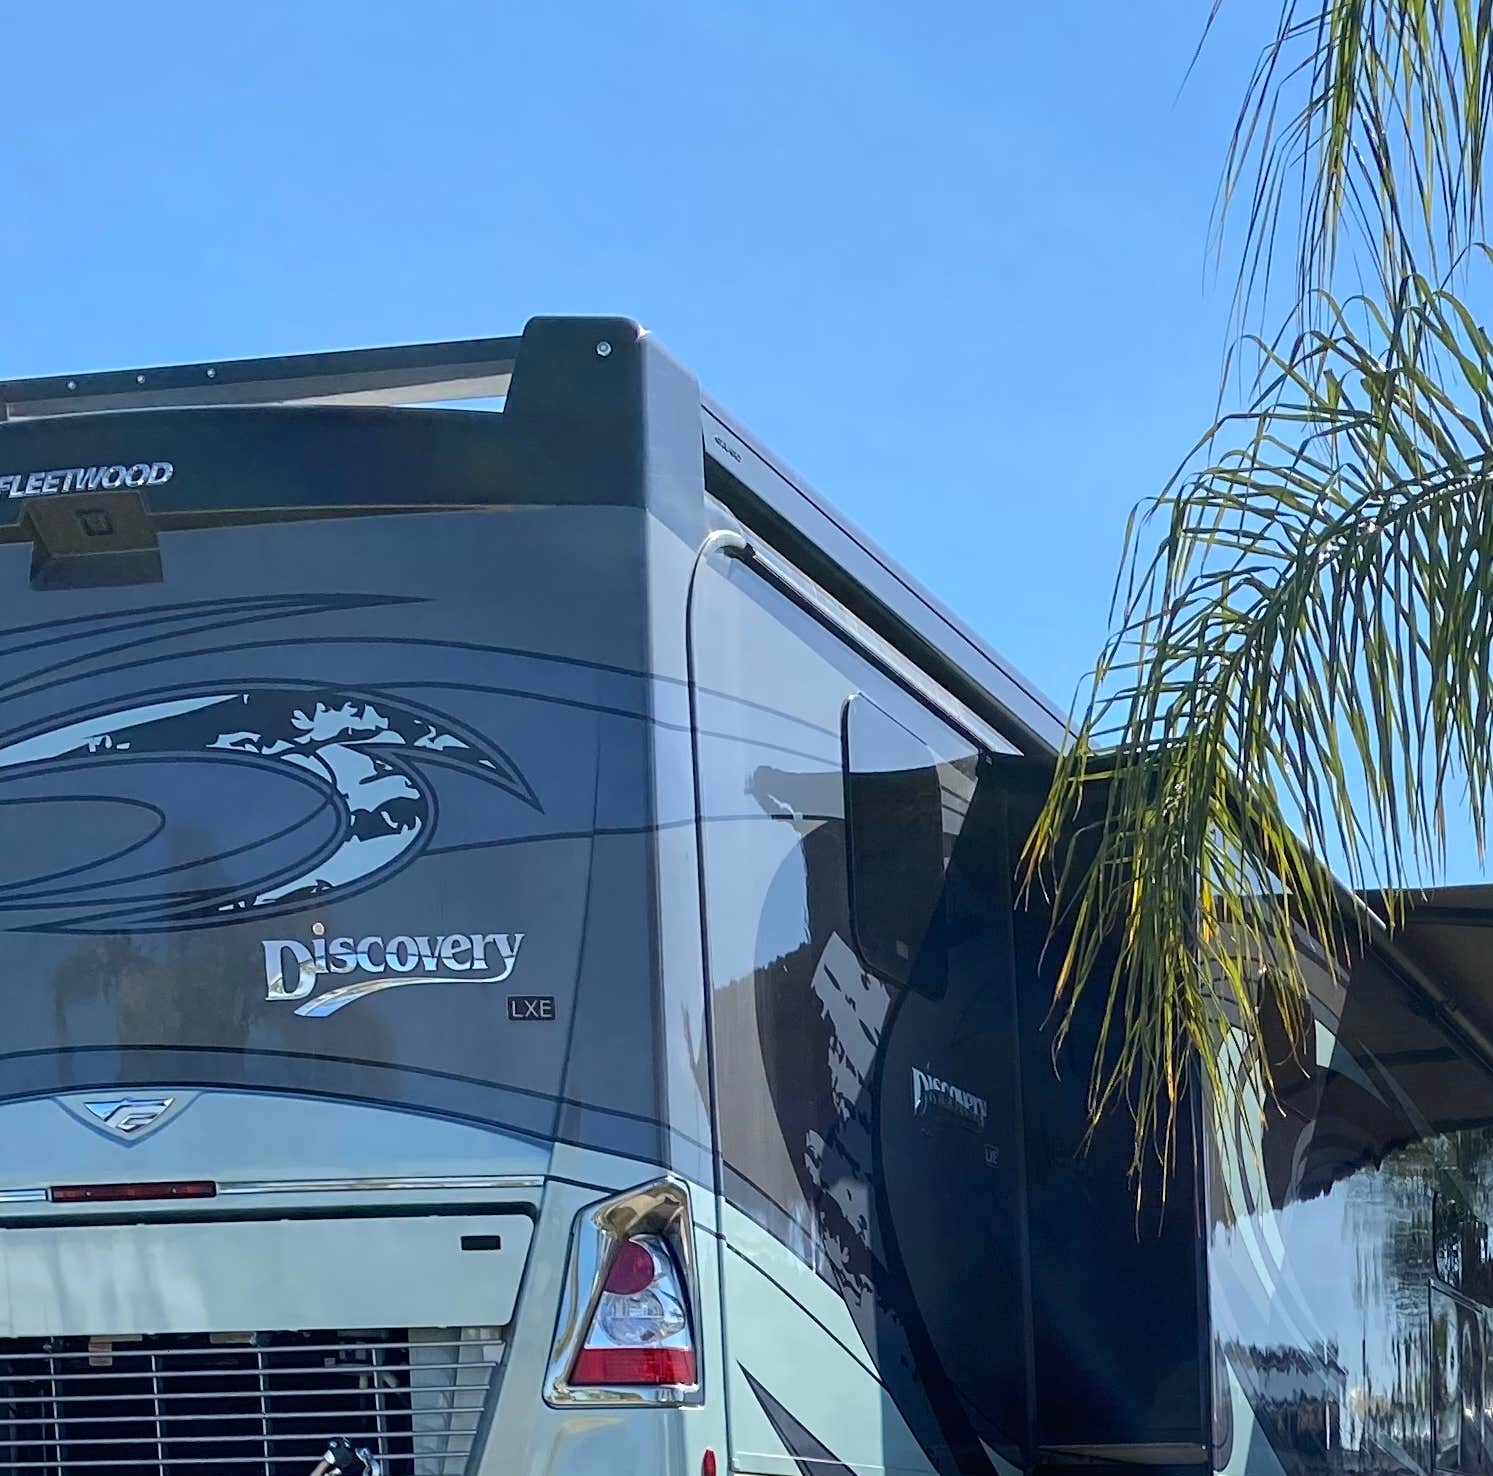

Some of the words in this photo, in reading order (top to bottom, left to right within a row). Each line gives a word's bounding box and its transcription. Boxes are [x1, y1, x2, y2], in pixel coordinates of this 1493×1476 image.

[0, 461, 173, 498] FLEETWOOD
[262, 922, 525, 1017] Discovery
[511, 999, 553, 1018] LXE
